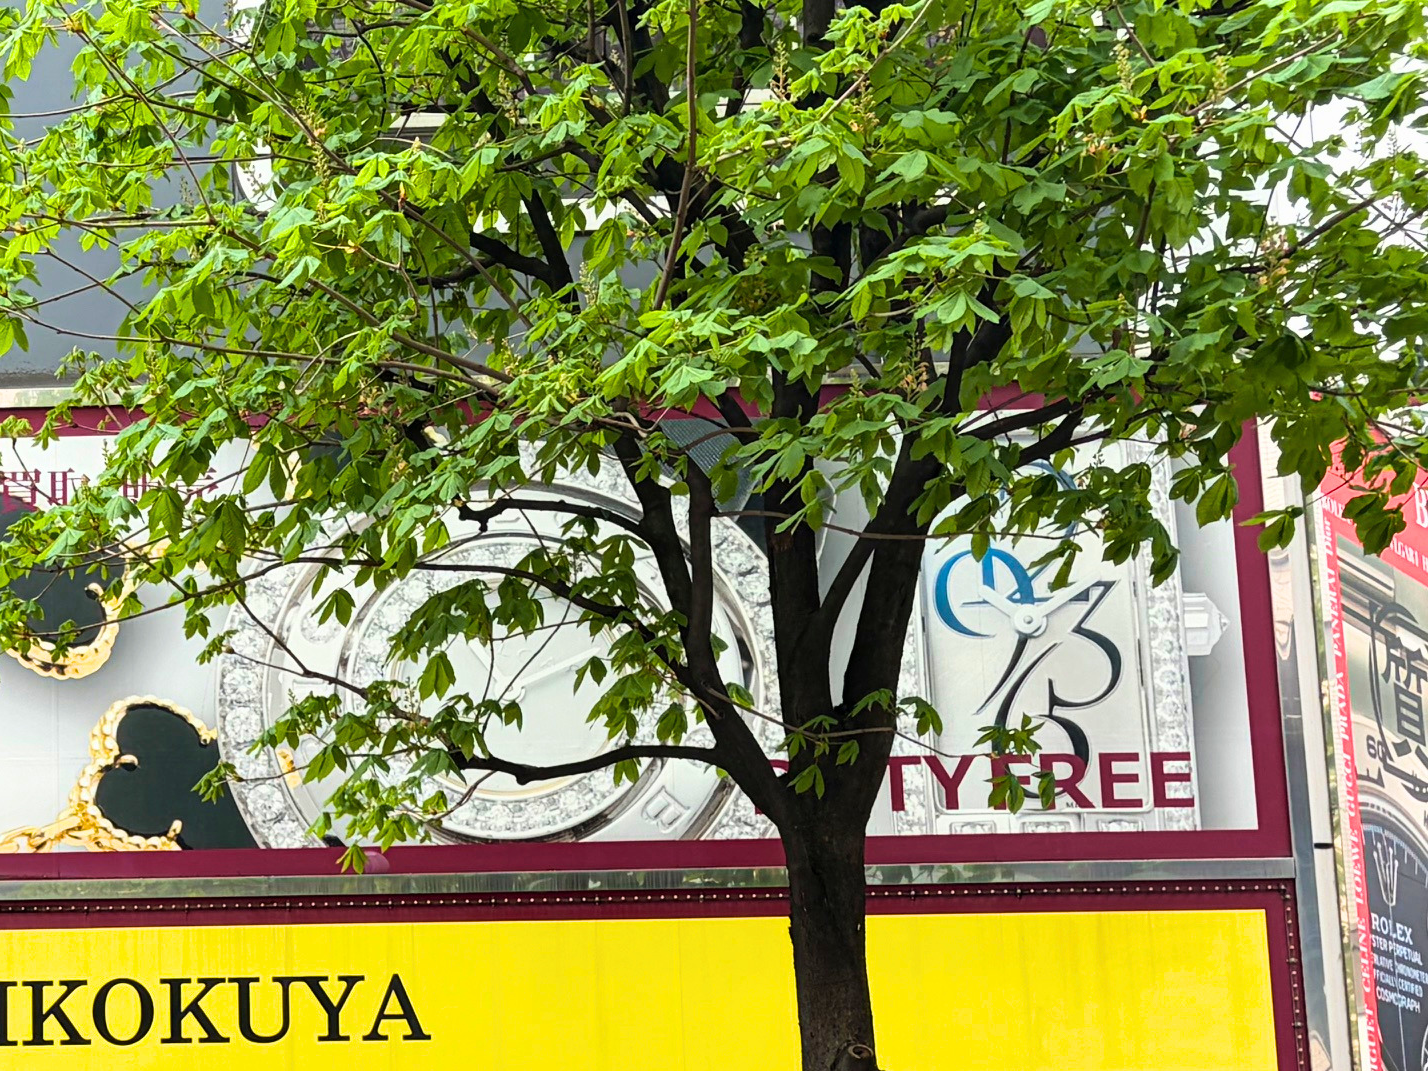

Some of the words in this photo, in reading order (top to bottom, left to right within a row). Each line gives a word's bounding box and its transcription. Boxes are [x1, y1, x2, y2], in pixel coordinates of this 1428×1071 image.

[1334, 672, 1351, 741] PRADA
[989, 751, 1195, 810] FREE
[1340, 756, 1355, 818] GUCCI
[1348, 828, 1363, 907] LOEWE
[1356, 916, 1371, 993] CELINE
[1371, 912, 1413, 945] ROLEX
